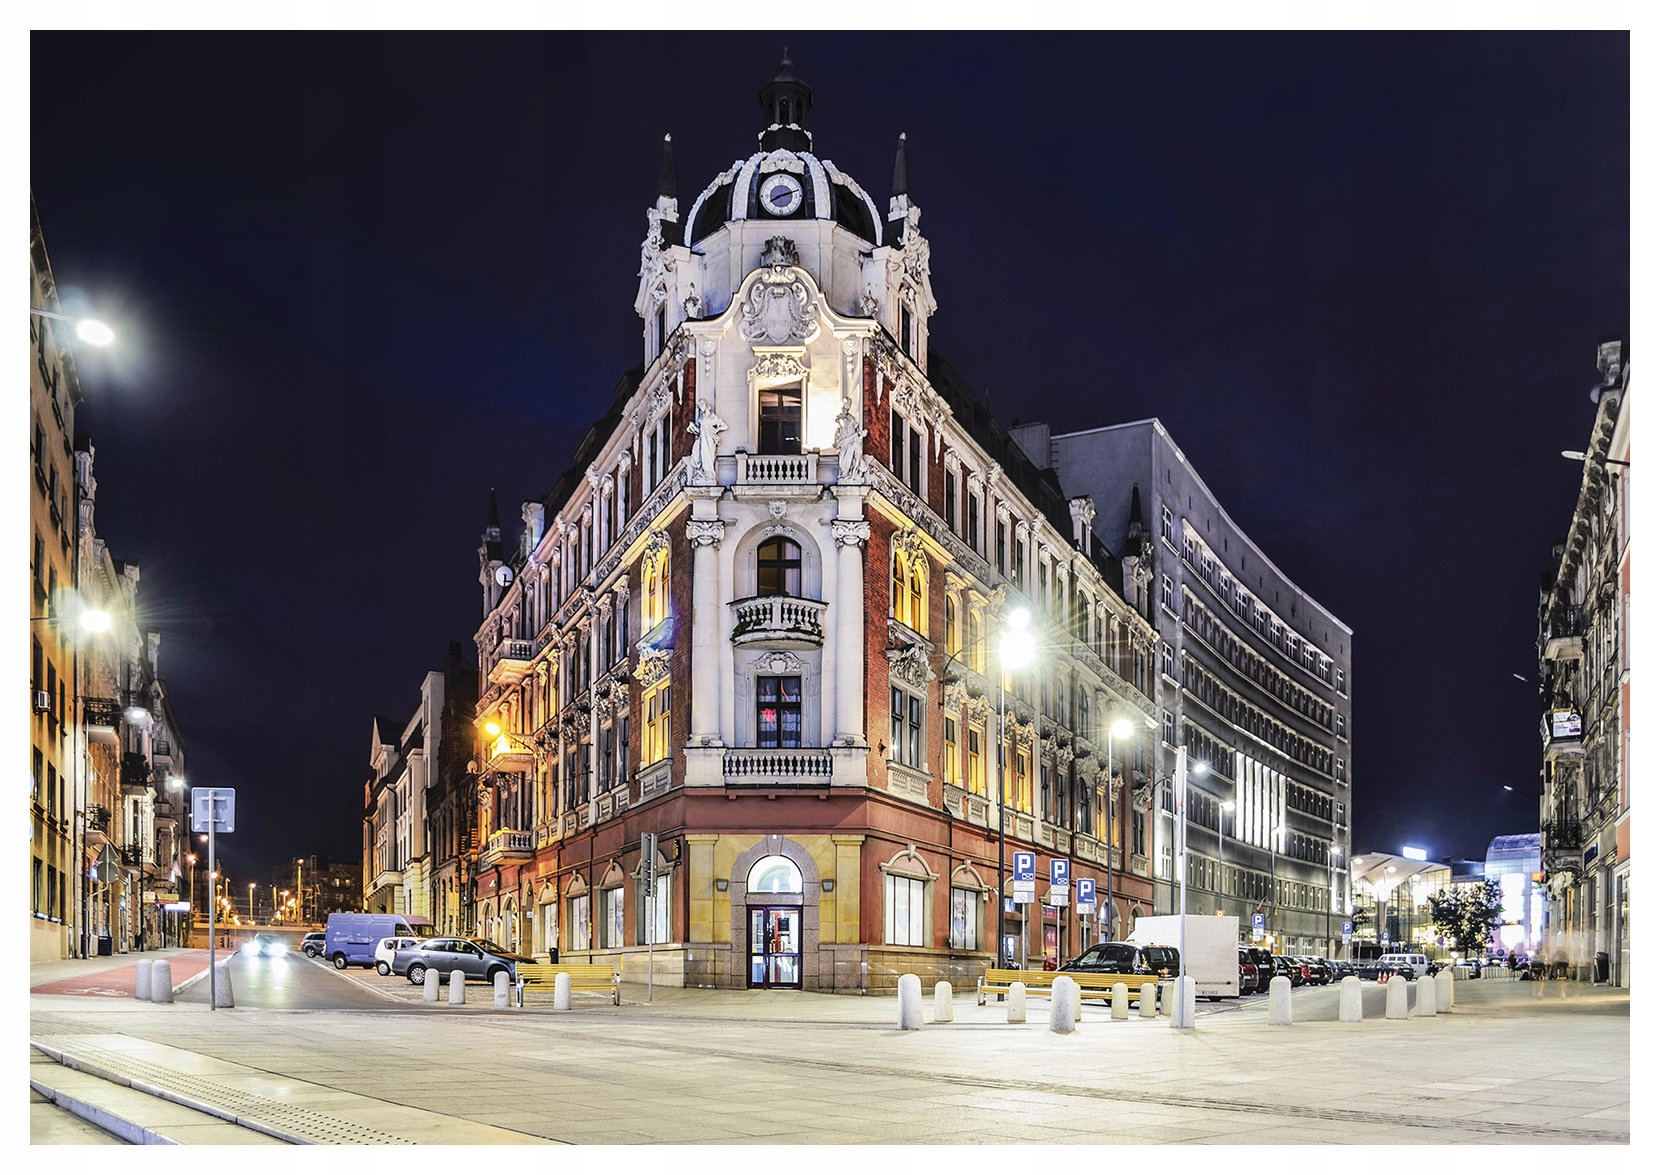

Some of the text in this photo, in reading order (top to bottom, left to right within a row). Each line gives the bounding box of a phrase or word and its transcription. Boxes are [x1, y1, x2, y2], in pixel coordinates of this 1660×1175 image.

[1018, 855, 1031, 873] P
[1054, 862, 1066, 878] P
[1080, 881, 1092, 897] P
[1254, 916, 1262, 924] P
